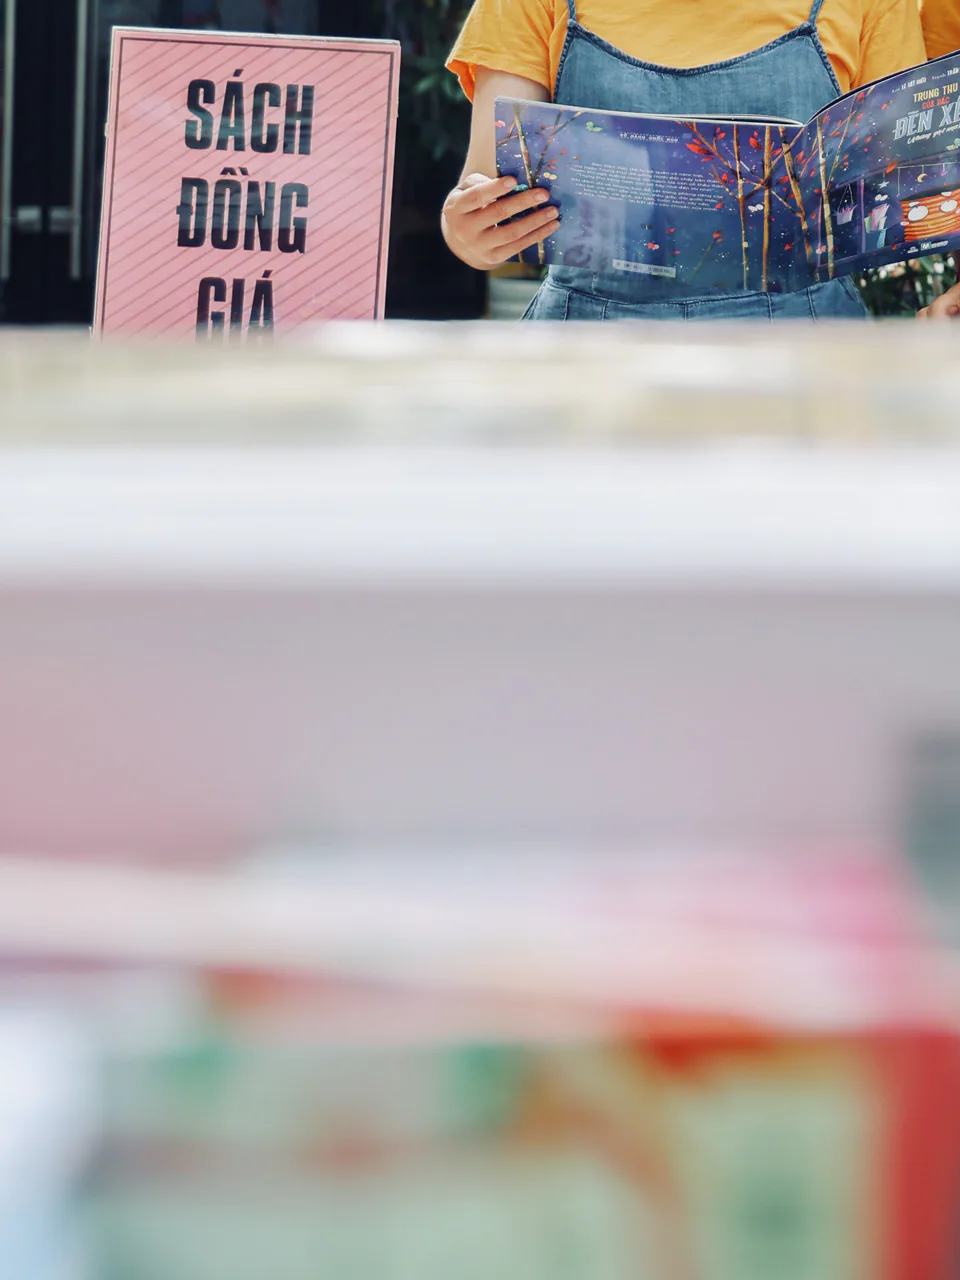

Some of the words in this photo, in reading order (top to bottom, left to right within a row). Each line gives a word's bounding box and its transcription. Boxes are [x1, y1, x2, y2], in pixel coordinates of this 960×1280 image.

[184, 69, 315, 156] SÁCH
[892, 108, 934, 141] ĐÈN
[913, 87, 940, 103] TRUNG
[942, 82, 959, 95] THU
[176, 167, 309, 254] ĐỒNG
[195, 270, 275, 342] GIÁ
